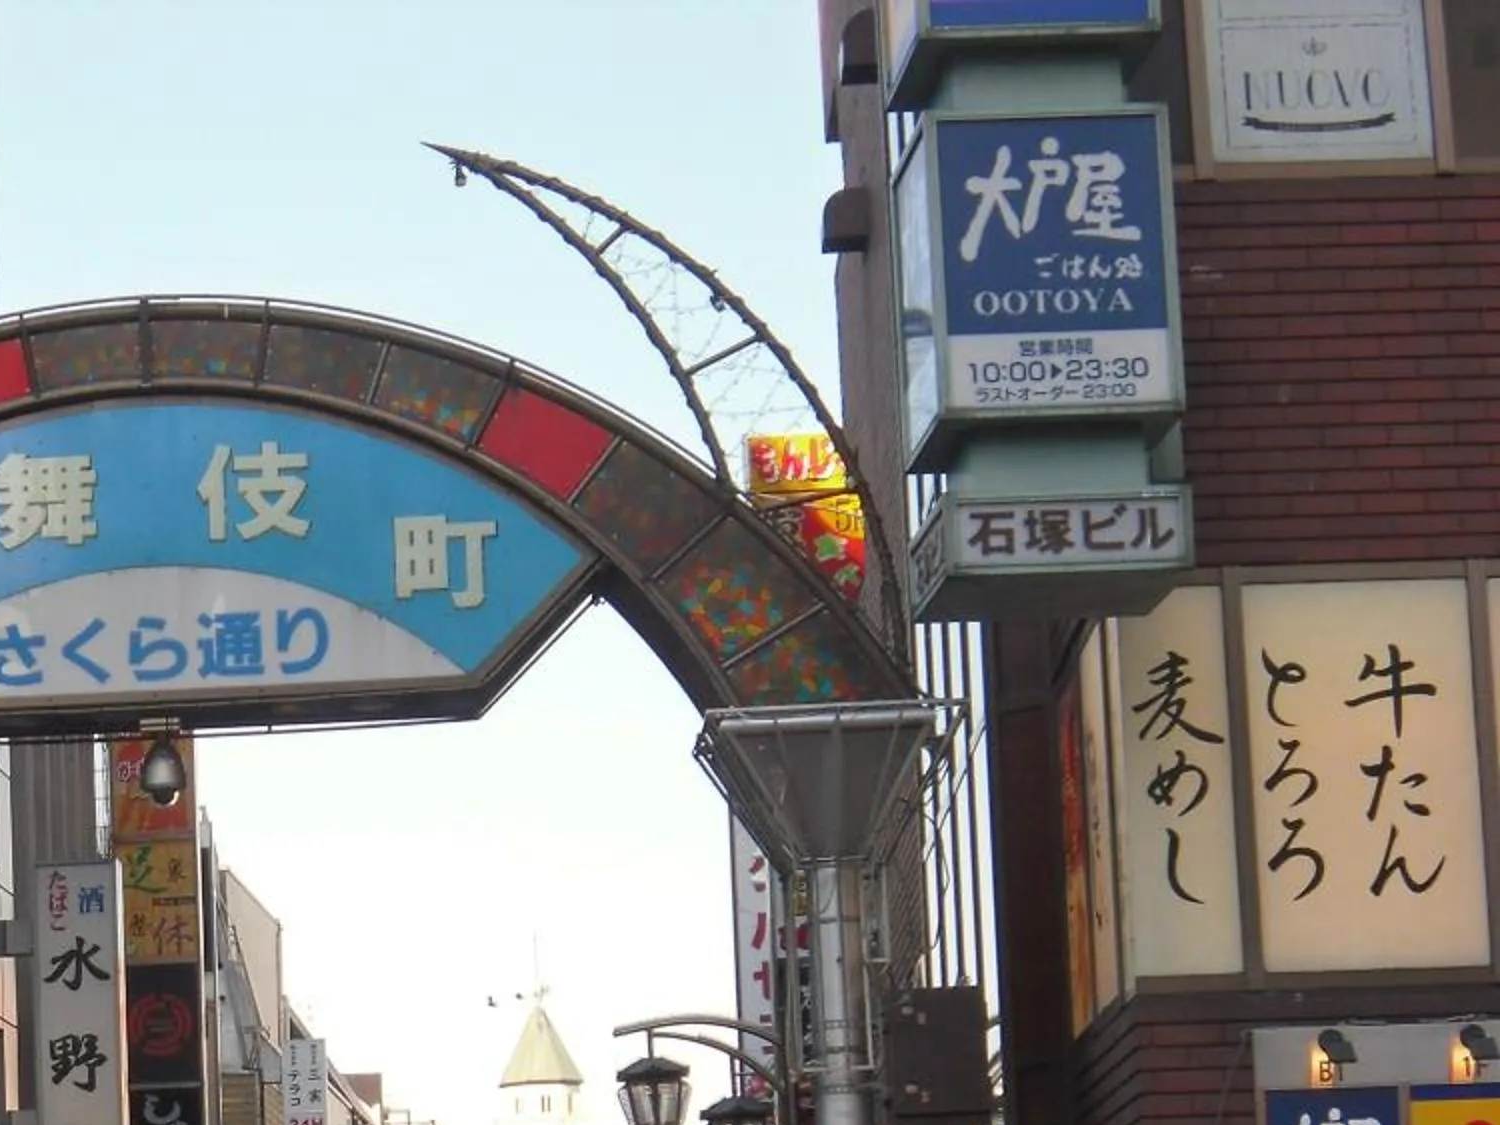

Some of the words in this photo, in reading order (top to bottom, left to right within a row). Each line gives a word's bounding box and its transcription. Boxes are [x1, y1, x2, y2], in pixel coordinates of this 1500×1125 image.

[1242, 69, 1391, 110] NUOVO
[960, 136, 1142, 262] 大戸屋
[974, 288, 1134, 315] OOTOYA
[968, 504, 1176, 556] 石塚ビル
[1131, 650, 1224, 905] 麦めし
[1261, 647, 1325, 902] とろろ
[1344, 645, 1446, 896] 牛たん
[47, 868, 70, 932] たばこ
[78, 884, 105, 915] 酒
